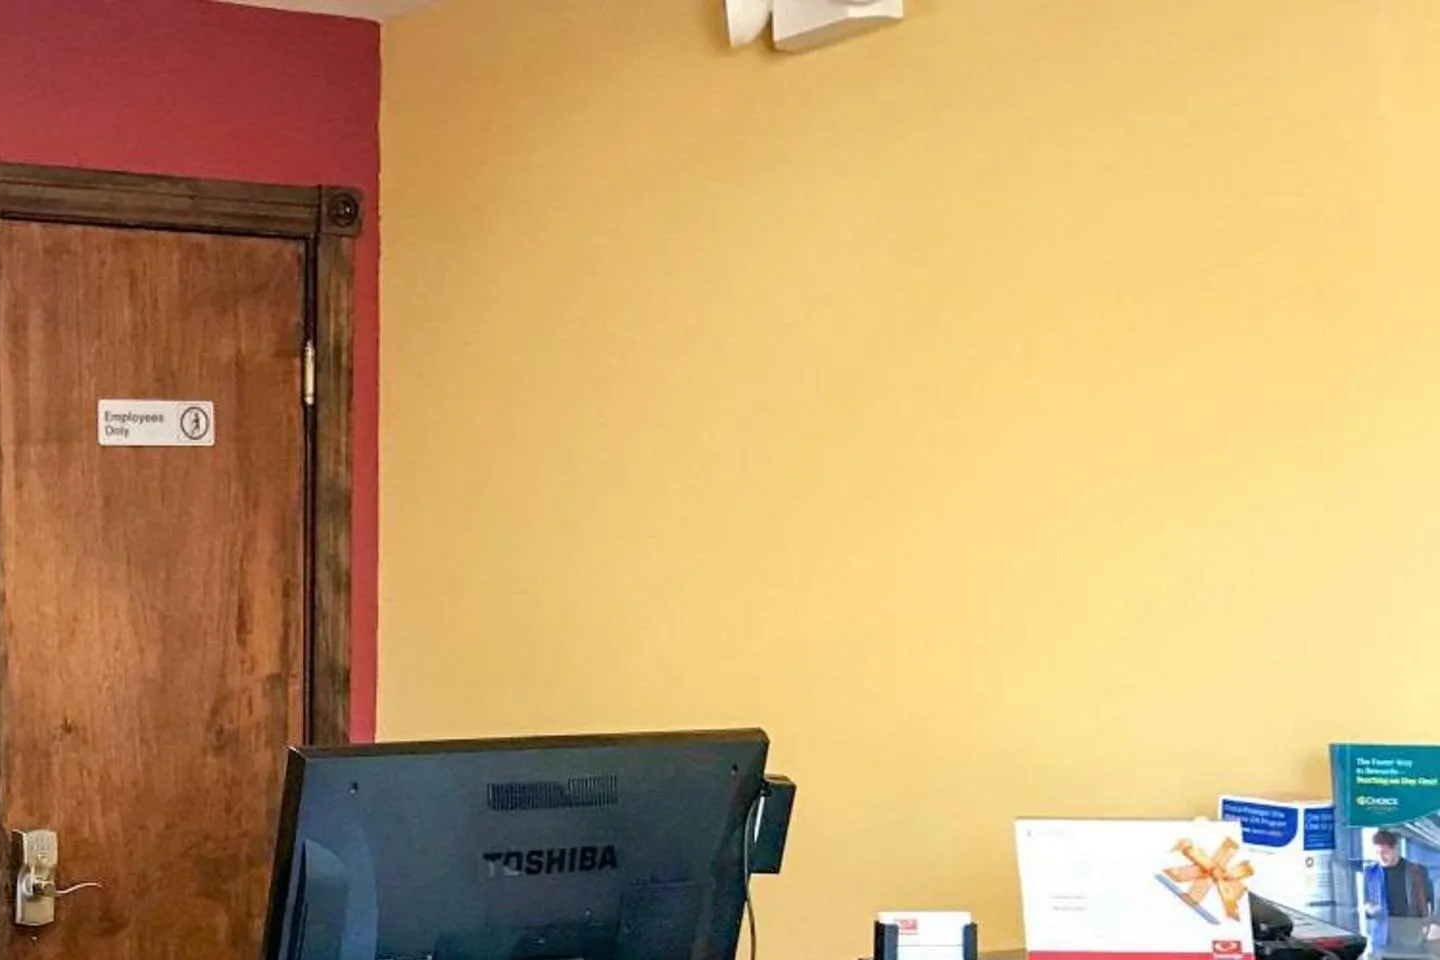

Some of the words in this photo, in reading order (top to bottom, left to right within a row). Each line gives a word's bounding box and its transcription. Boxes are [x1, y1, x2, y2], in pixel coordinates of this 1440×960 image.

[104, 411, 164, 424] Employees
[105, 425, 129, 438] Only
[483, 845, 618, 877] TOSHIBA
